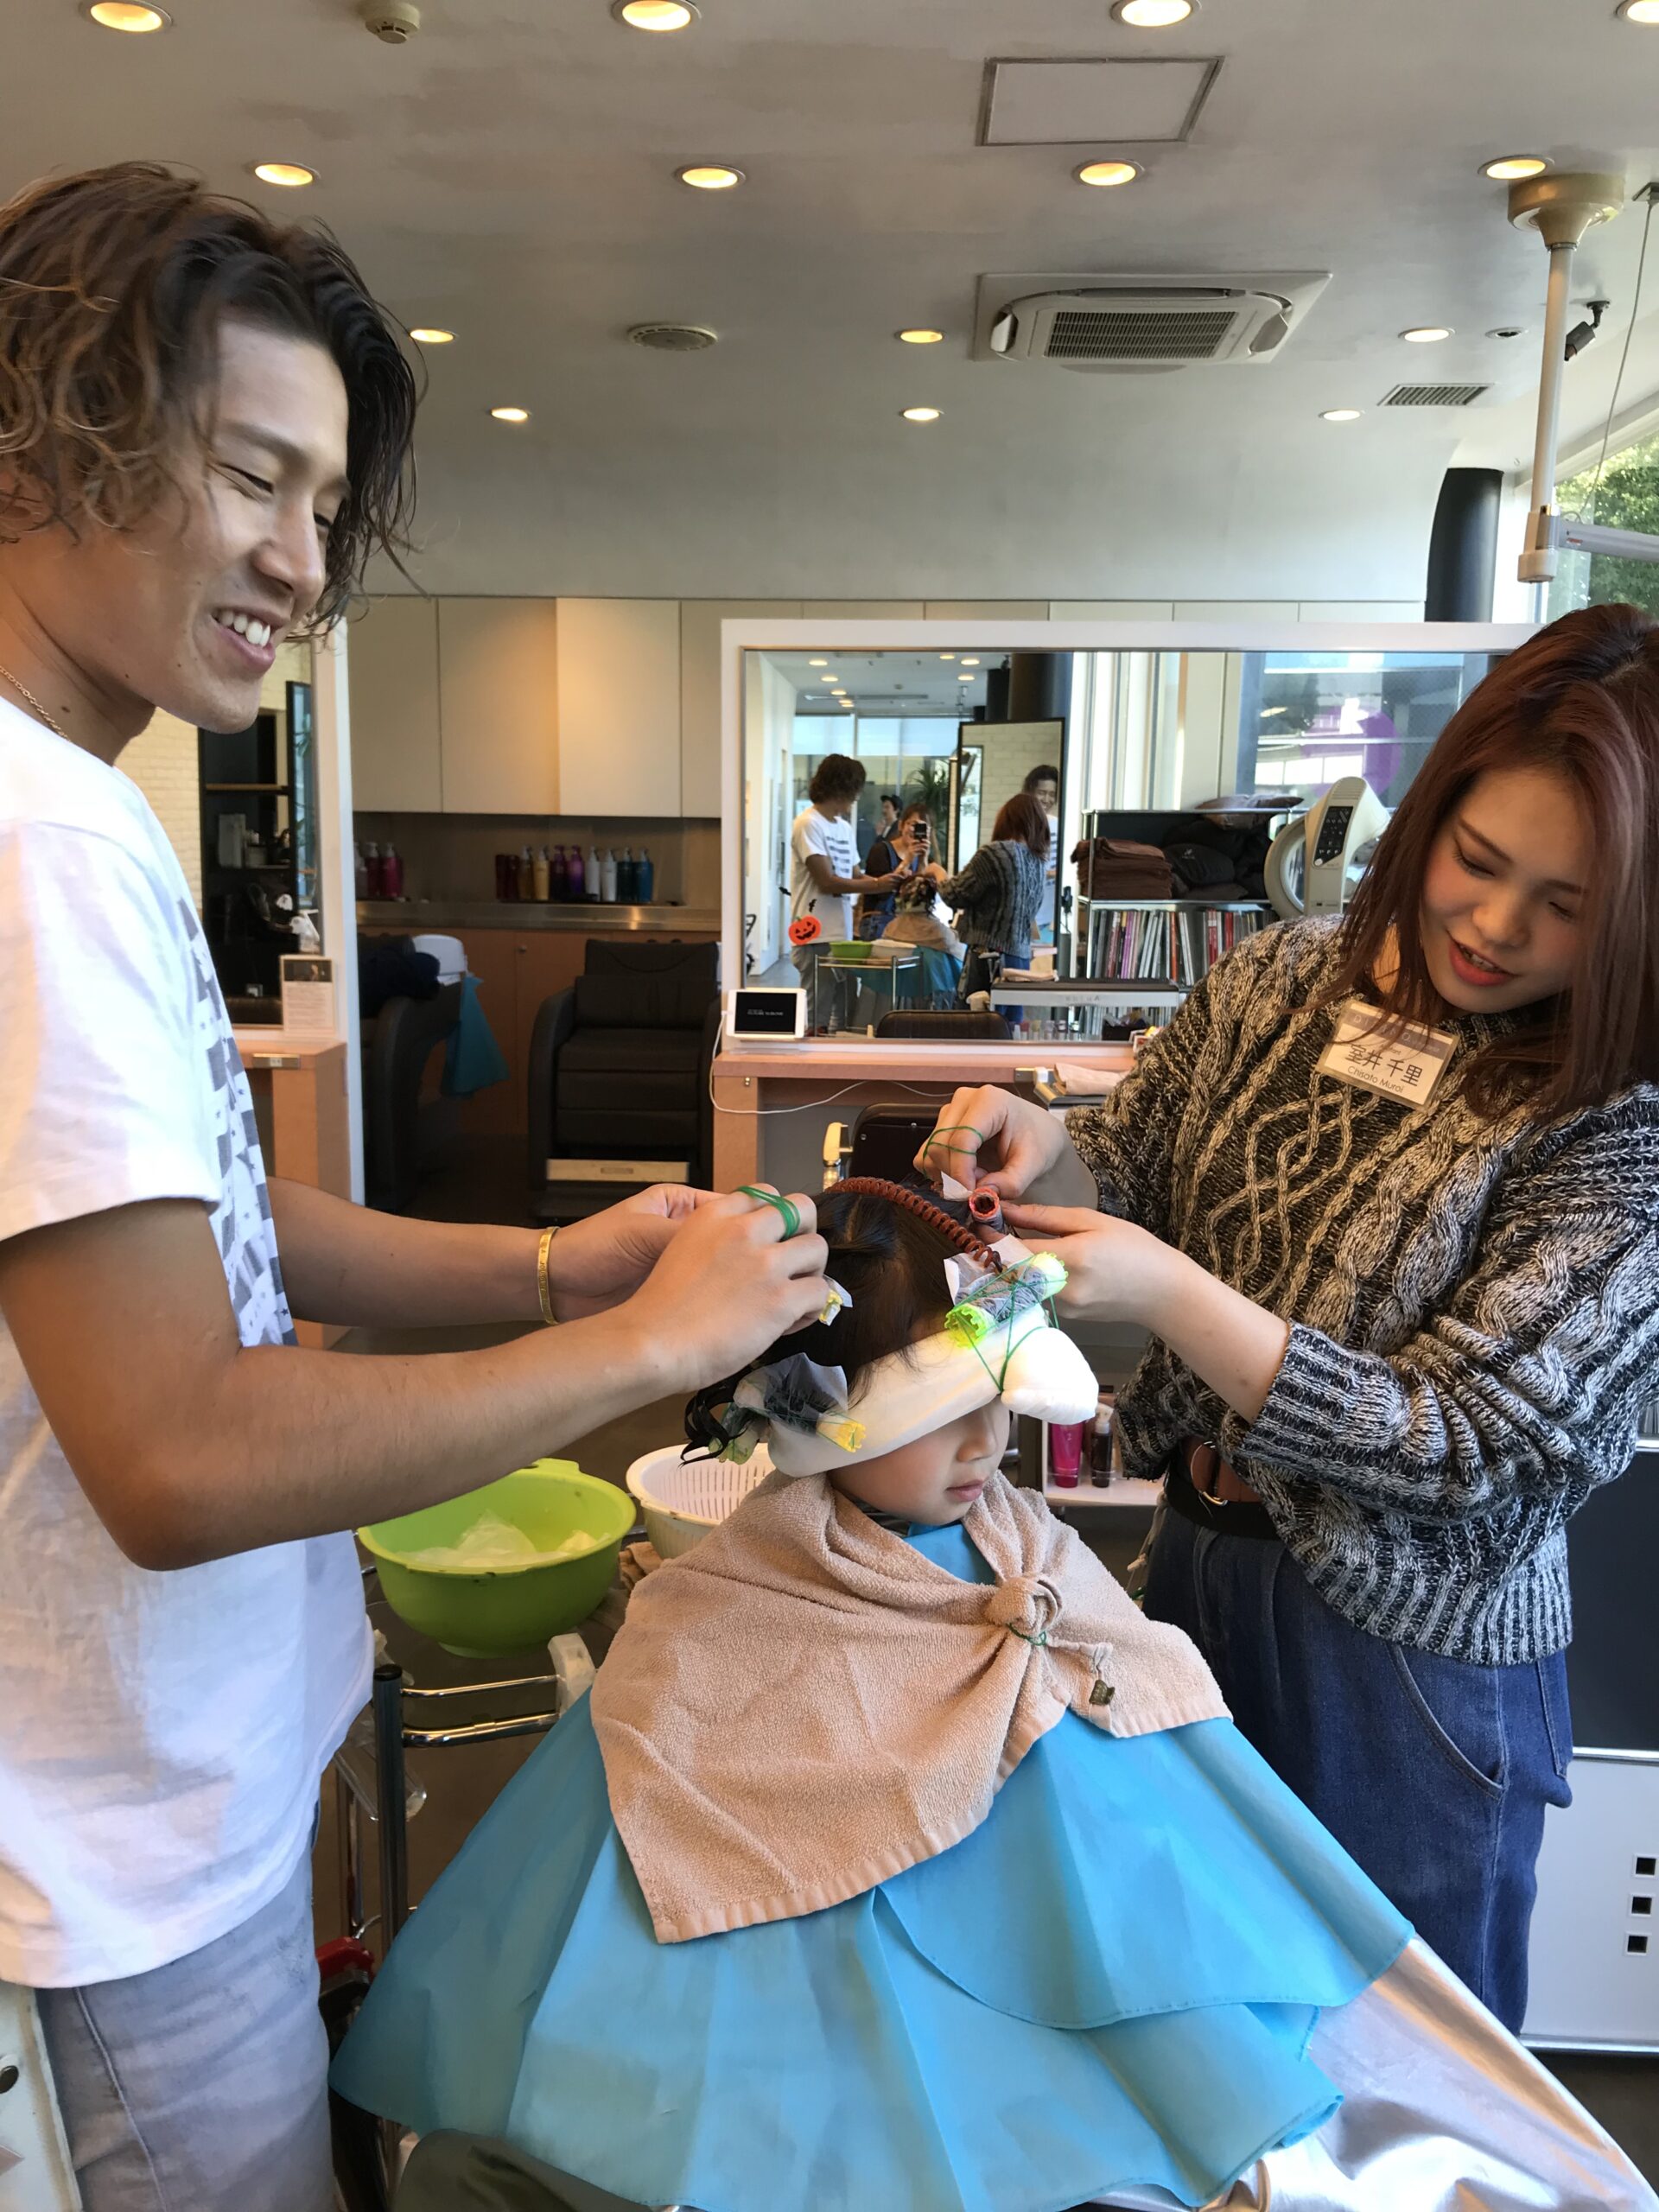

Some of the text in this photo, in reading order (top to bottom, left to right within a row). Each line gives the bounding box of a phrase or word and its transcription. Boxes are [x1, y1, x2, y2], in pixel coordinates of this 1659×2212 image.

[1344, 1044, 1382, 1070] 室井
[1387, 1058, 1422, 1087] 千里
[1348, 1065, 1406, 1093] Chisato Muroi
